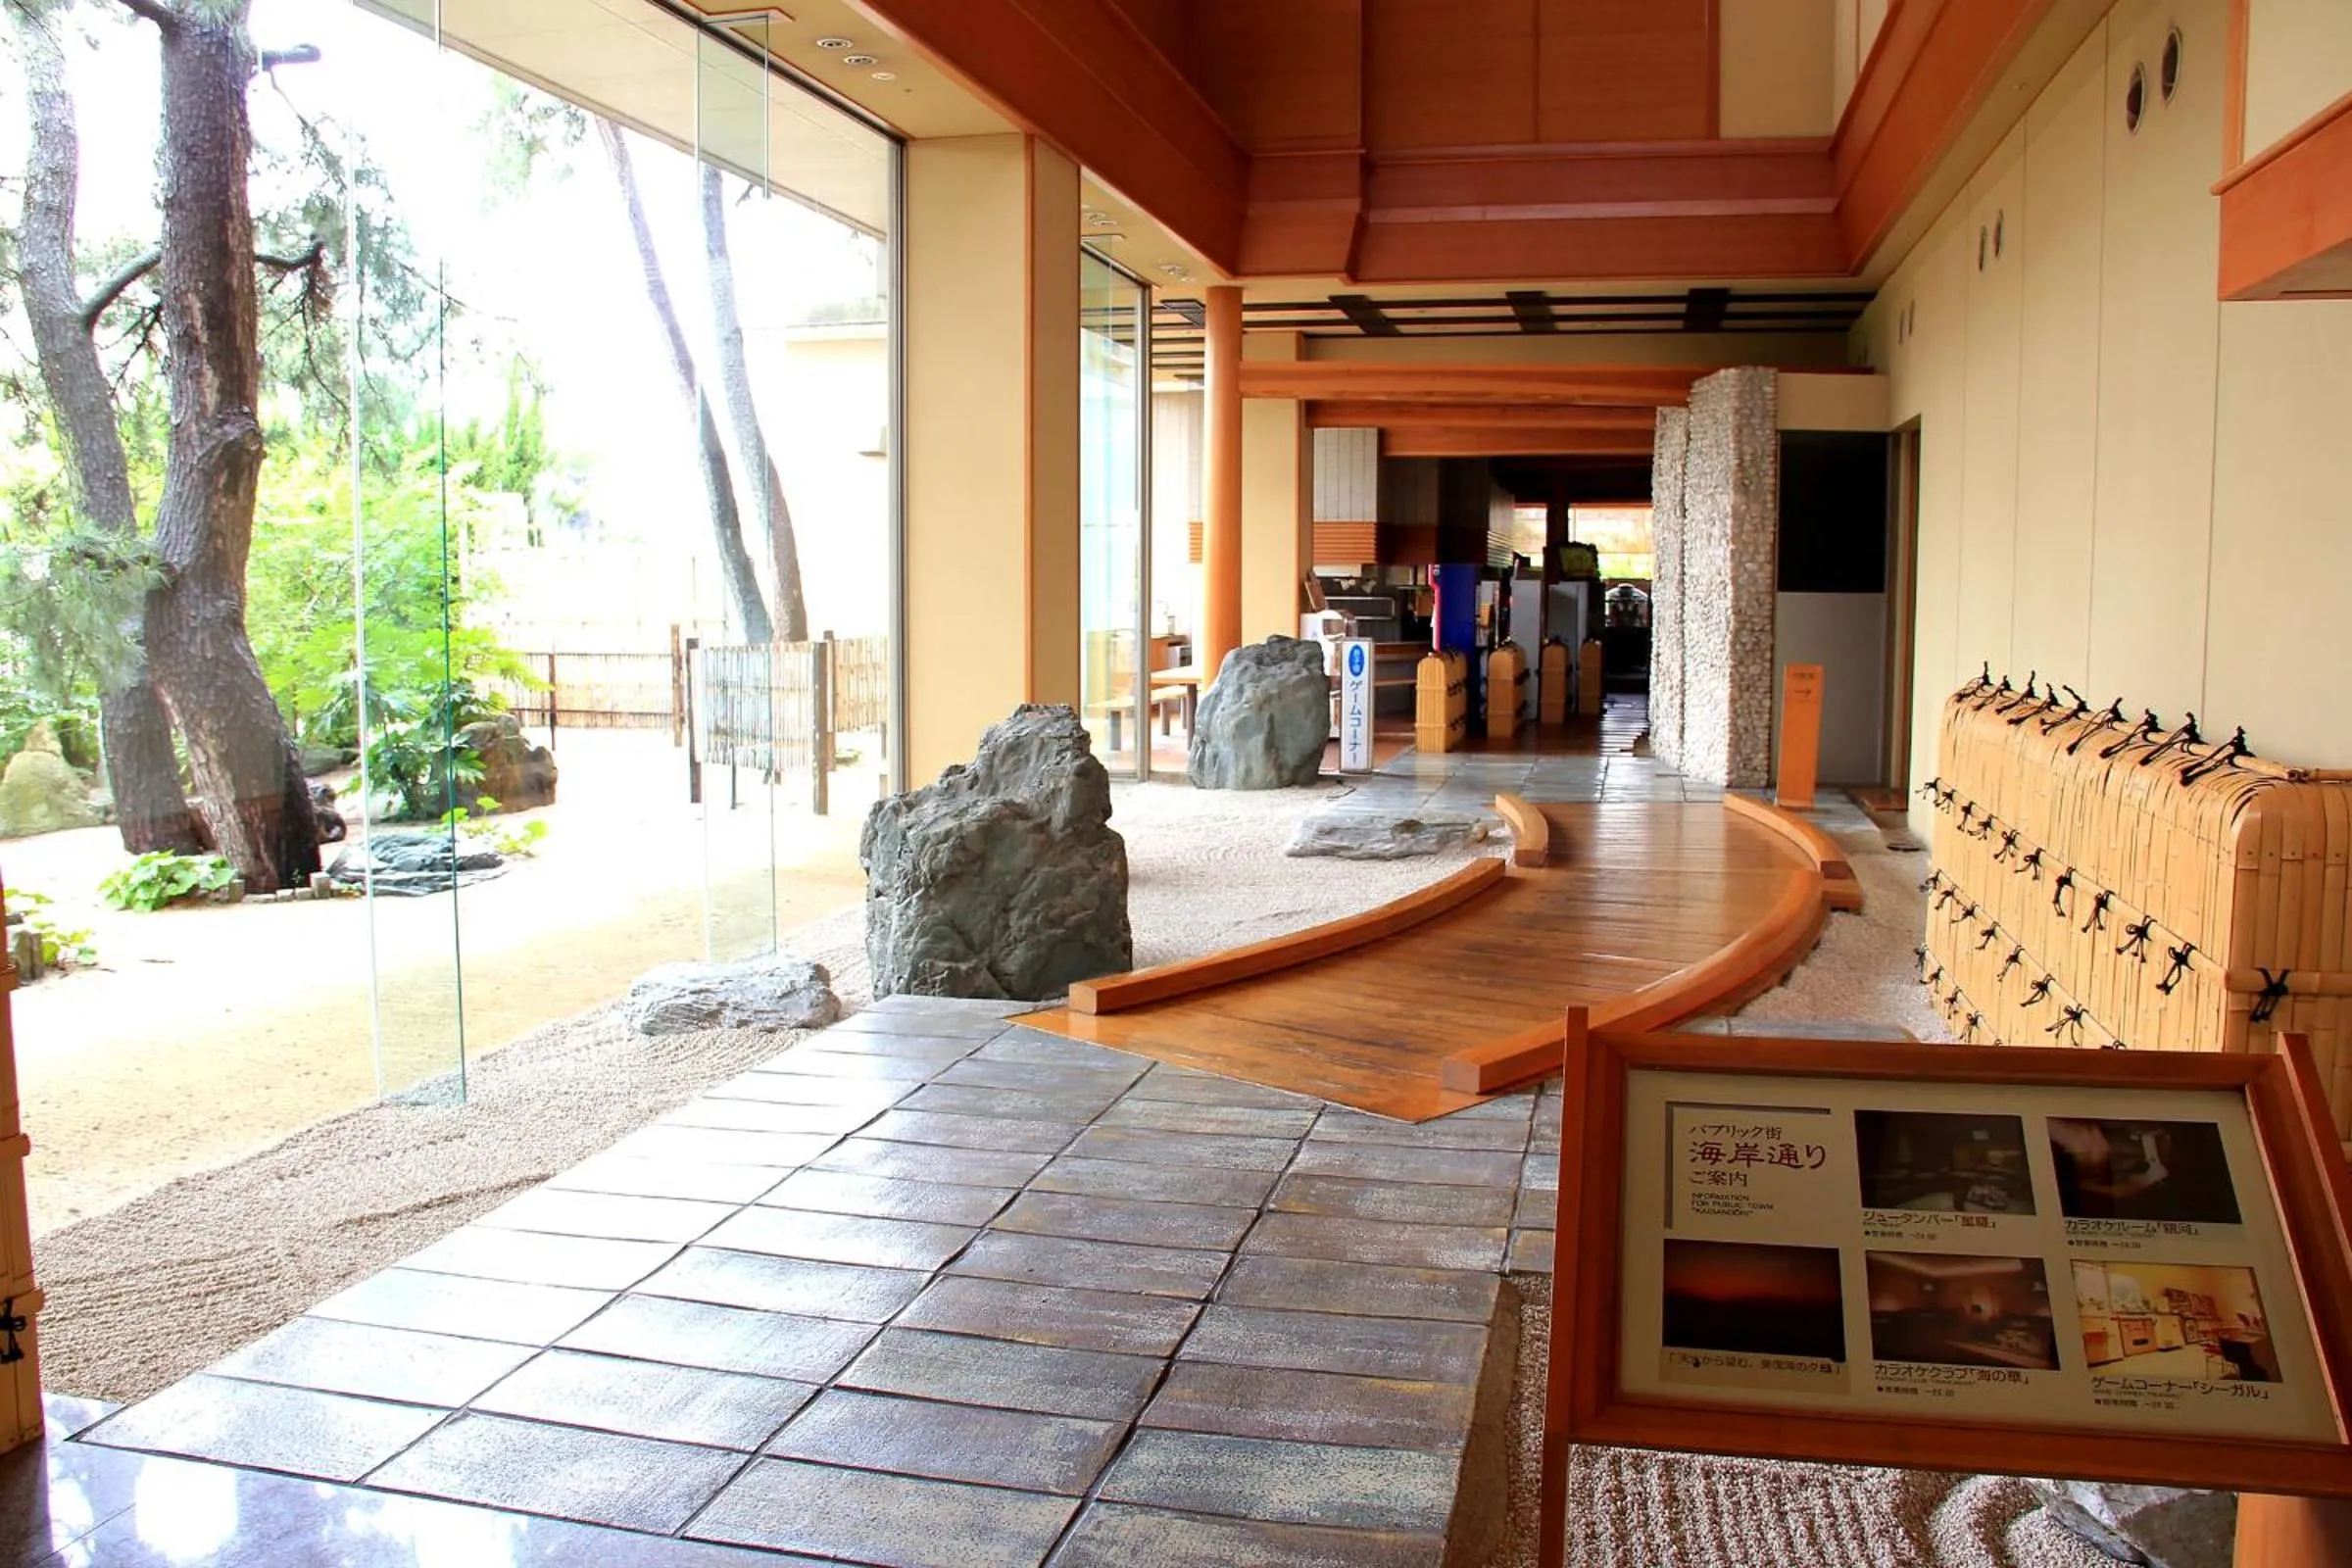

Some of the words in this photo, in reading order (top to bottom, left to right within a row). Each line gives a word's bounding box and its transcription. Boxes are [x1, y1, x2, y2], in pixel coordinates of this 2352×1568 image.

[1348, 679, 1363, 764] ゲームコーナー
[1689, 1124, 1783, 1142] パブリック街
[1689, 1141, 1827, 1169] 海岸通り
[1689, 1170, 1748, 1188] ご案内
